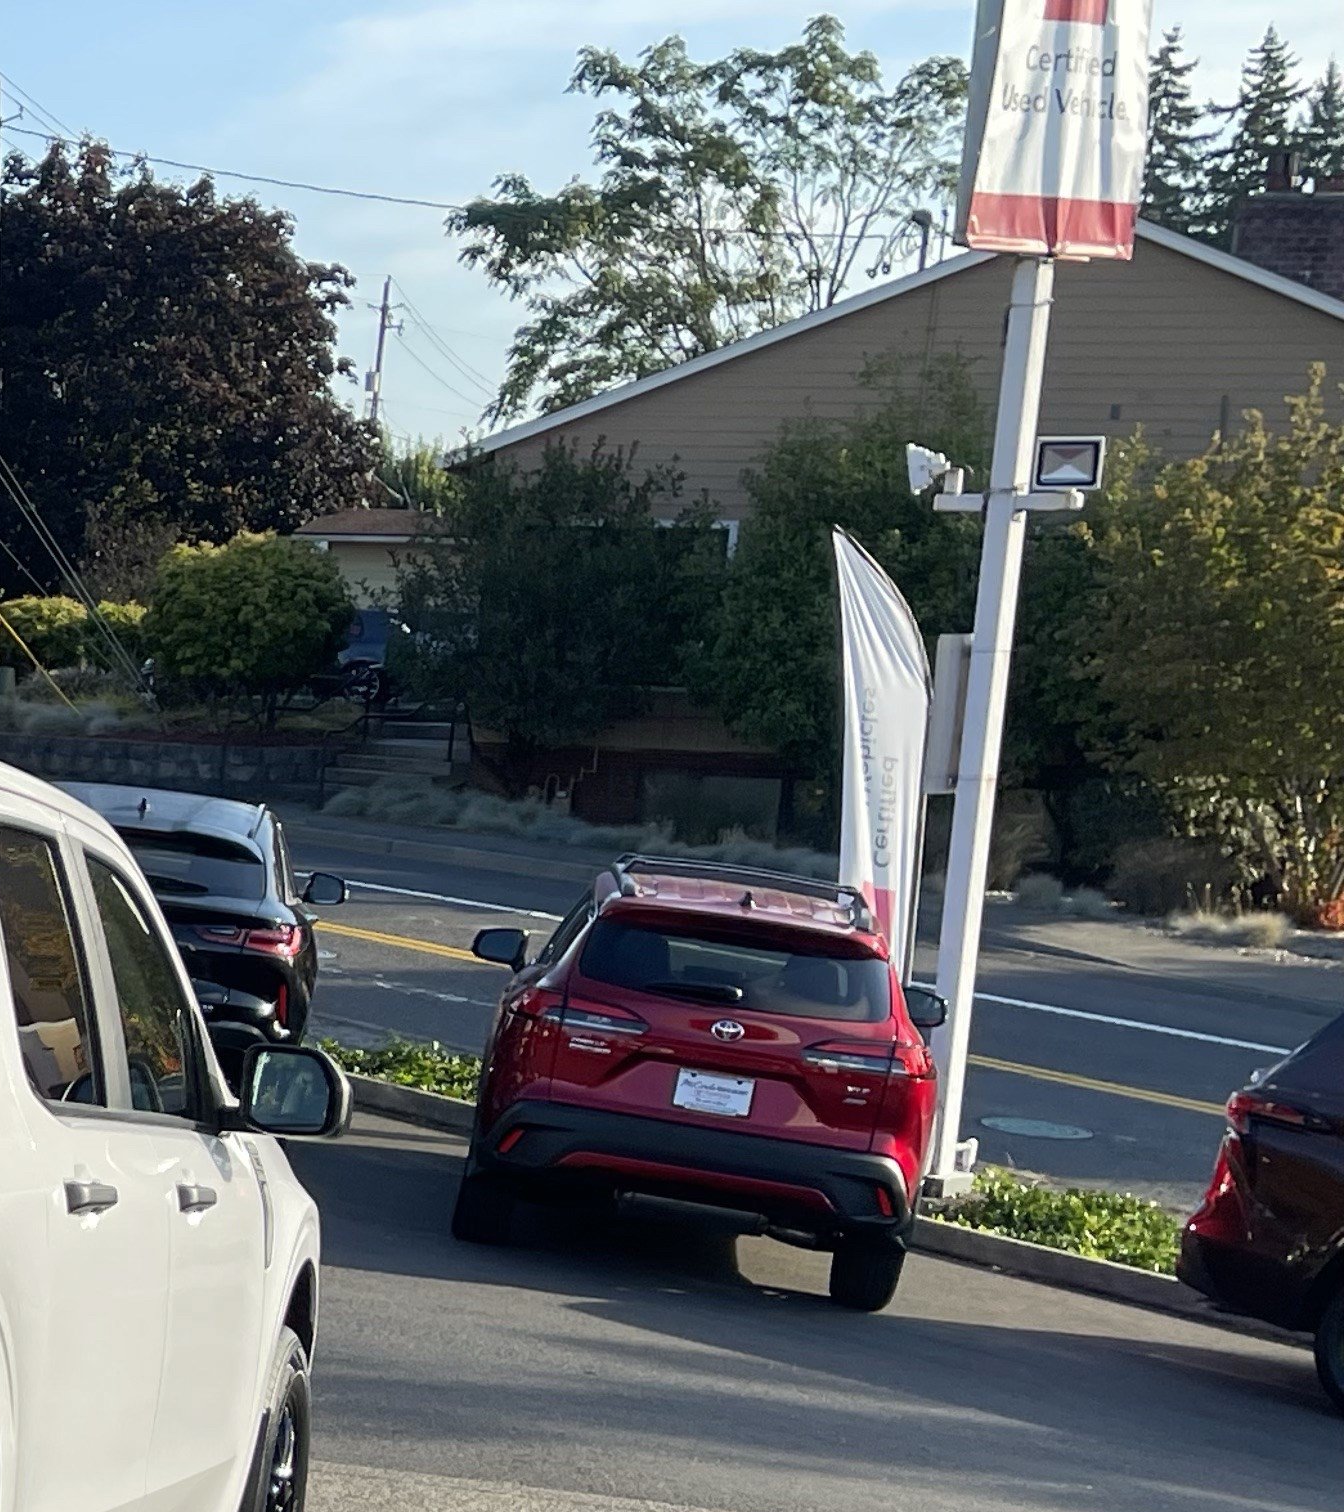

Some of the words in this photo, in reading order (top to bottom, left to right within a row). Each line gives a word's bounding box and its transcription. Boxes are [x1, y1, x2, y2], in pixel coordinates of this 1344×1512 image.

[1025, 44, 1118, 77] Certified
[1002, 82, 1048, 113] Used
[1054, 88, 1130, 121] Vehicle
